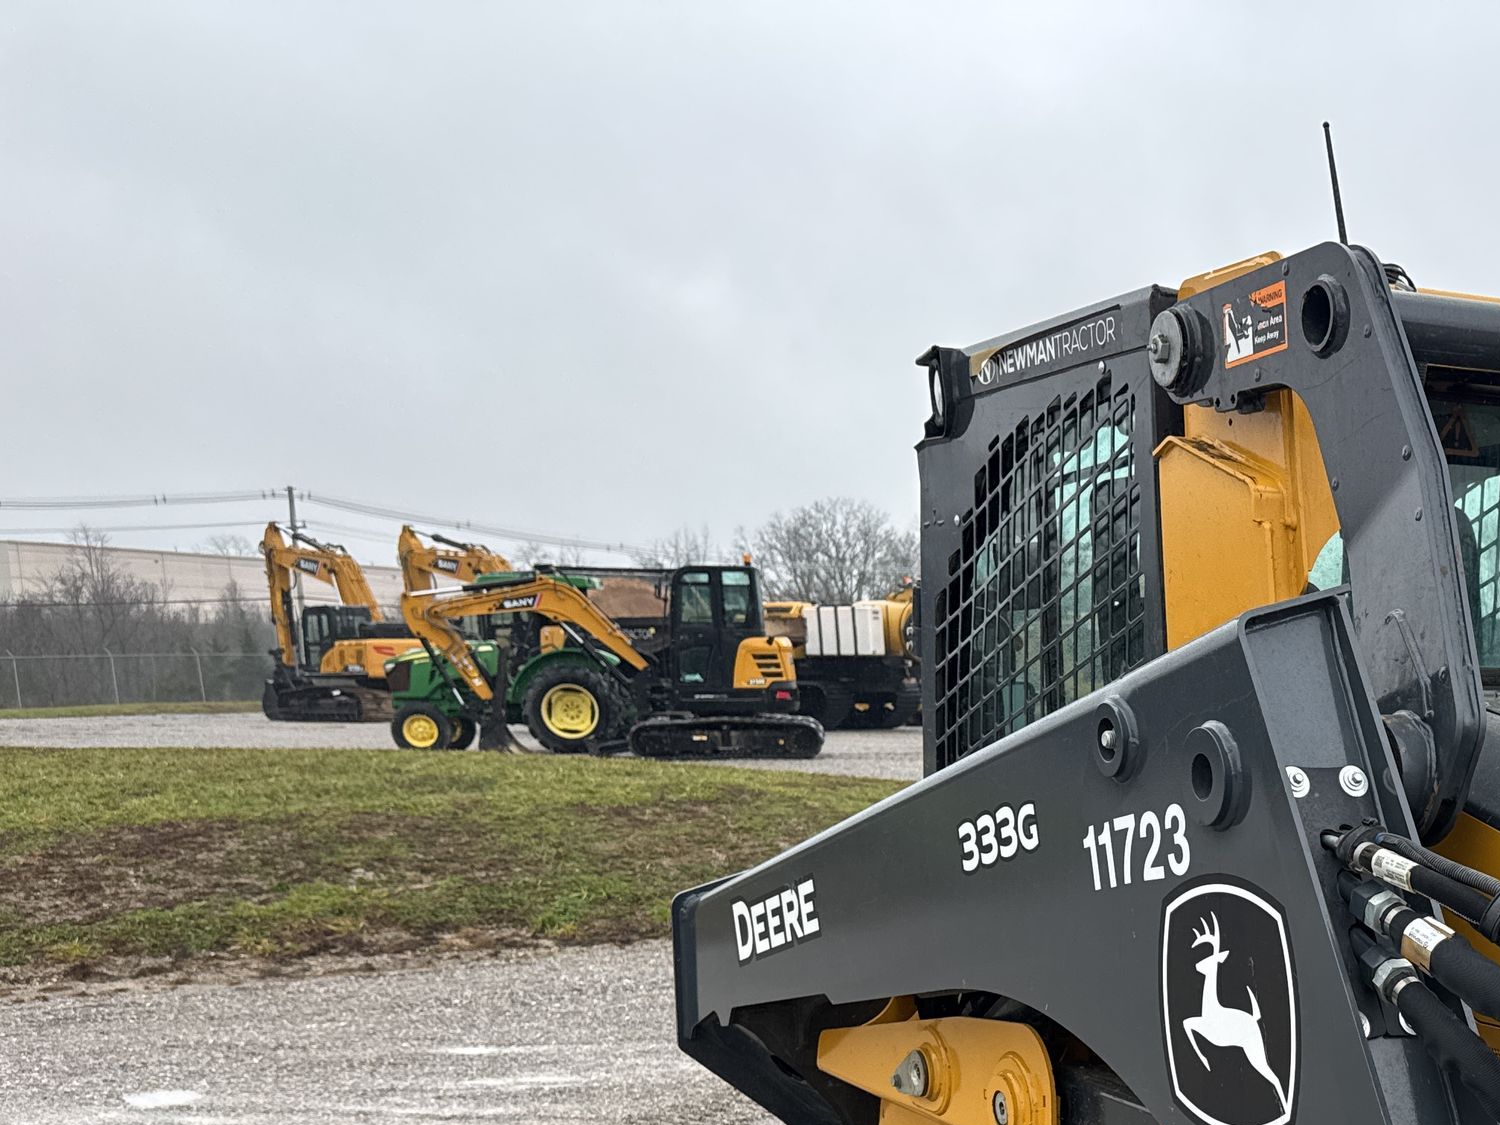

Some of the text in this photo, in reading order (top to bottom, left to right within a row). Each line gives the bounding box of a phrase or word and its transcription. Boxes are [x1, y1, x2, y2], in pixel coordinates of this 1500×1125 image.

[1254, 330, 1280, 345] Keep Away
[503, 596, 535, 609] SANY
[958, 803, 1040, 872] 333G
[1083, 803, 1192, 891] 11723
[731, 878, 820, 963] DEERE
